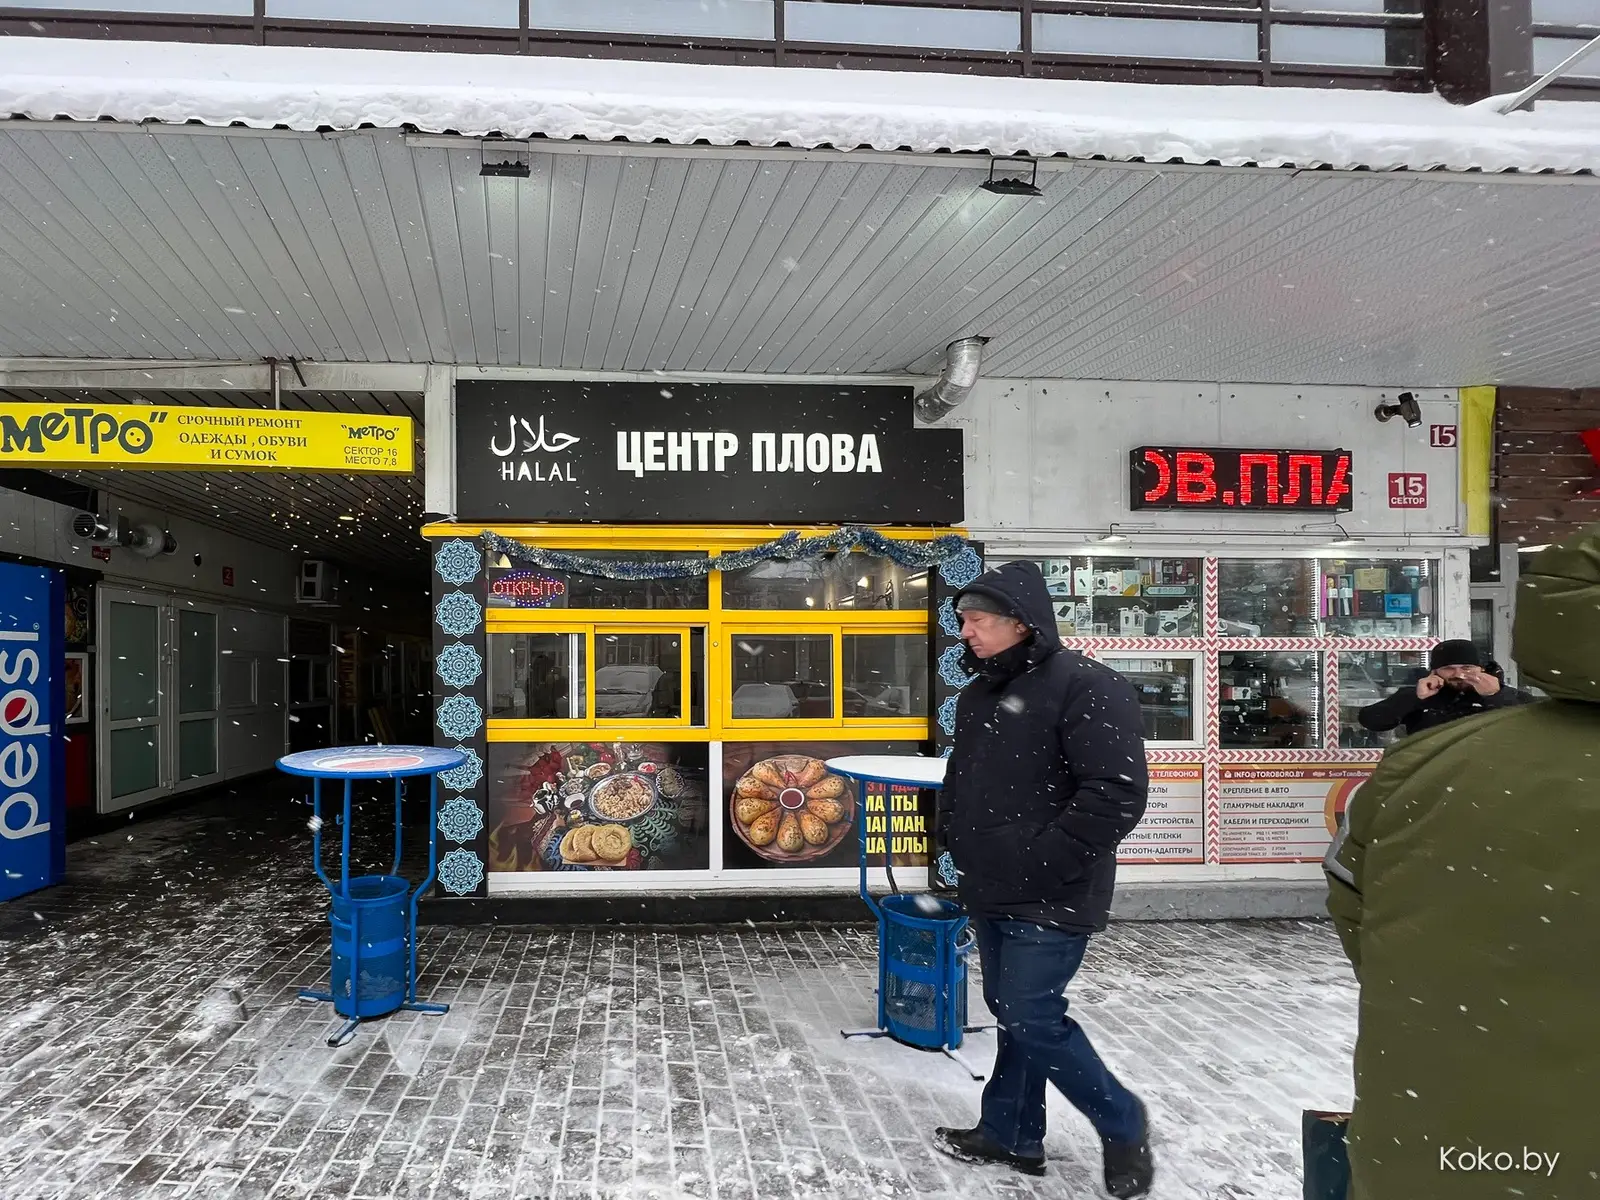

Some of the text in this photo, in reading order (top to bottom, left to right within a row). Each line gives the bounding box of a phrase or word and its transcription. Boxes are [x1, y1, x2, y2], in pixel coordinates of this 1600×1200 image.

[177, 415, 302, 428] СРОЧНЫЙ РЕМОНТ
[258, 435, 308, 447] ОБУВИ
[490, 414, 581, 457] حلال
[1432, 425, 1456, 447] 15
[210, 449, 278, 461] И СУМОК
[344, 446, 398, 457] СЕКТОР 16
[616, 431, 883, 478] ЦЕНТР ПЛОВА
[345, 455, 397, 466] МЕСТО 7,8
[501, 461, 577, 482] HALAL
[1394, 477, 1423, 496] 15
[1390, 497, 1425, 505] СЕКТОР
[492, 581, 565, 596] ОТКРЫТО
[0, 629, 51, 840] pepsi
[1150, 817, 1194, 825] УСТРОЙСТВА
[1258, 818, 1309, 826] ПЕРЕХОДНИКИ
